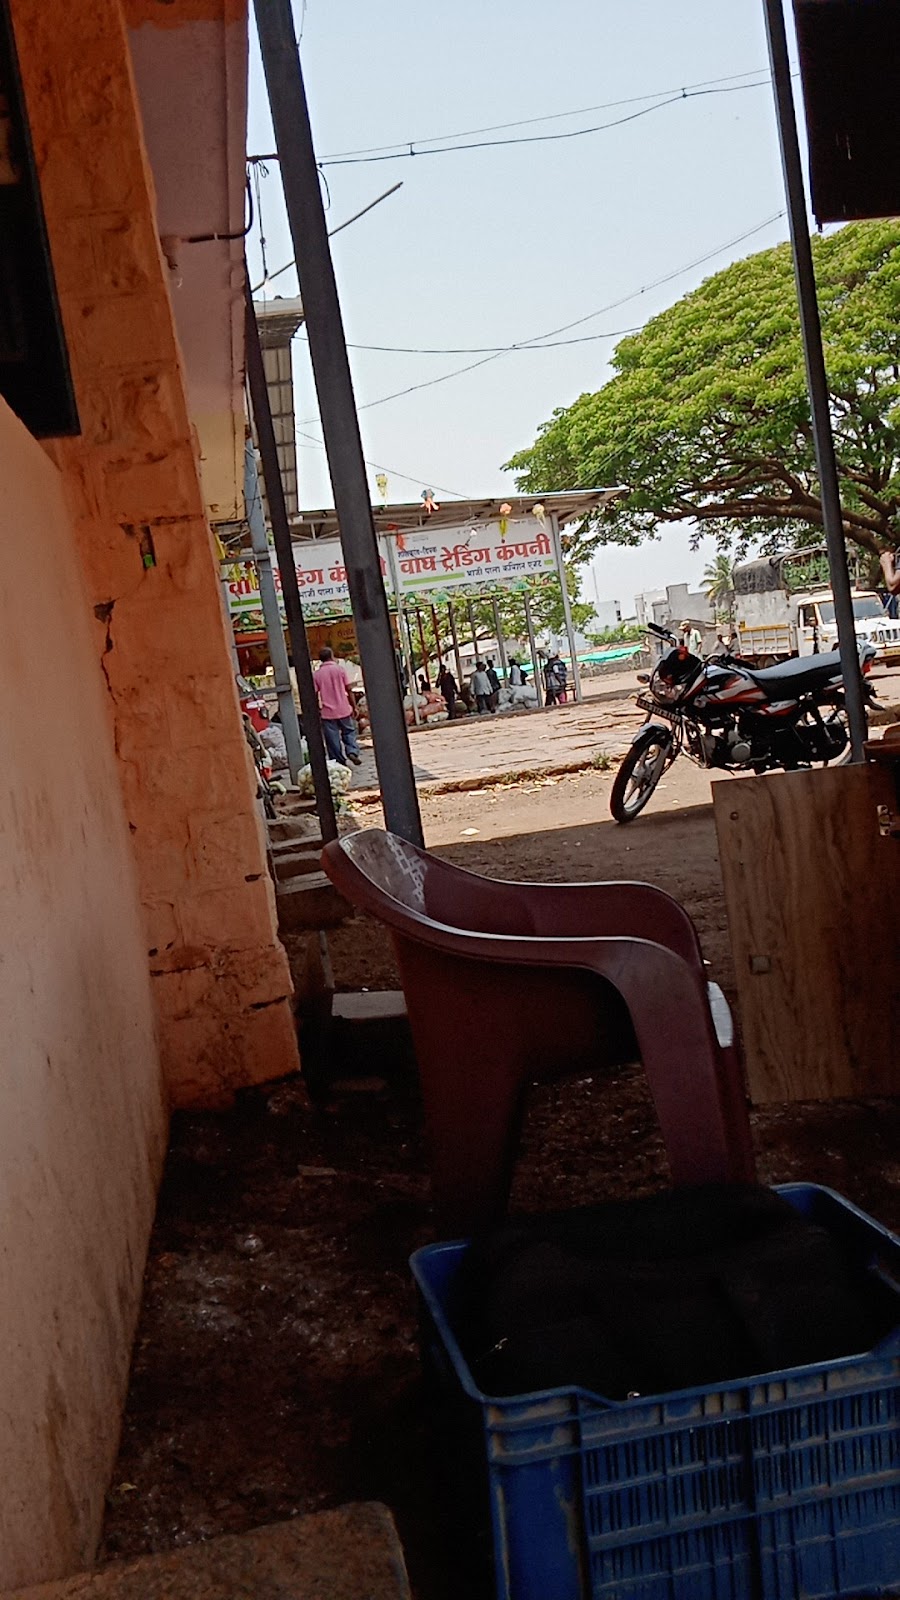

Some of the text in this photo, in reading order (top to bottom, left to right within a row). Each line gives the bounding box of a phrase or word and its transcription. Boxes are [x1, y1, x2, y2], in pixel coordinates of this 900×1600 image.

[399, 533, 551, 575] वाघ ट्रेडिंग कंपनी
